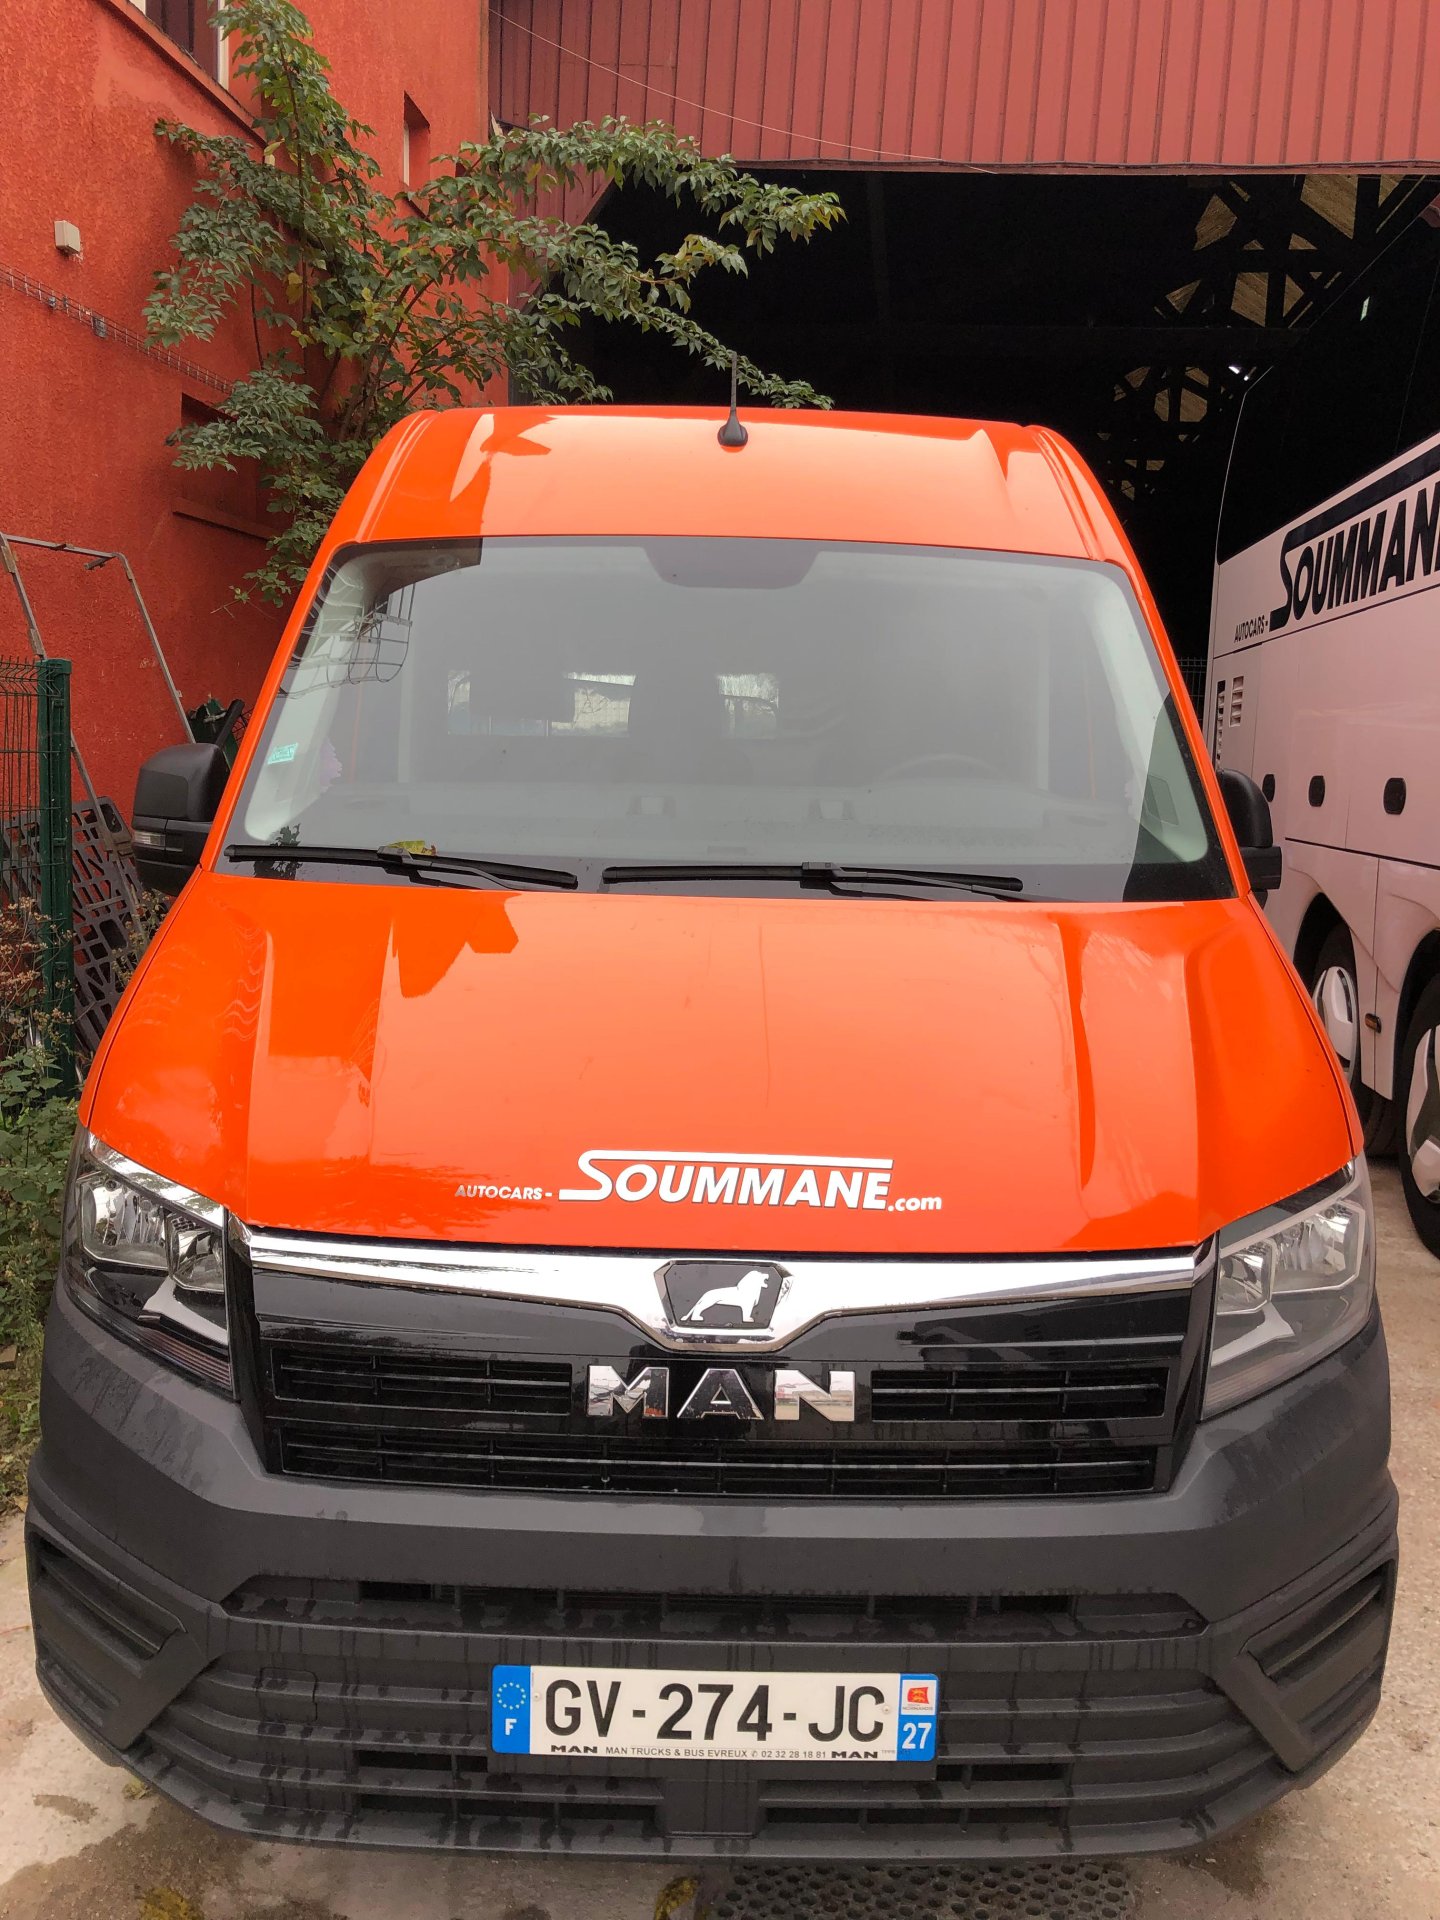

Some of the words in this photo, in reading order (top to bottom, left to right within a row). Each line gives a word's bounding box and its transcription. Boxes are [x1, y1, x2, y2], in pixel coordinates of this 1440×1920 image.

[586, 1364, 855, 1422] MAN
[545, 1679, 885, 1743] GV-274-JC
[505, 1718, 517, 1736] F
[902, 1722, 932, 1749] 27
[550, 1744, 598, 1754] MAN
[605, 1746, 628, 1755] MAN
[630, 1747, 671, 1756] TRUCKS
[674, 1748, 680, 1756] &
[684, 1749, 705, 1757] BUS
[707, 1749, 748, 1758] EVREUX
[761, 1750, 773, 1758] 02
[775, 1750, 786, 1758] 32
[803, 1751, 813, 1759] 18
[815, 1751, 826, 1759] 81
[831, 1750, 878, 1759] MAN
